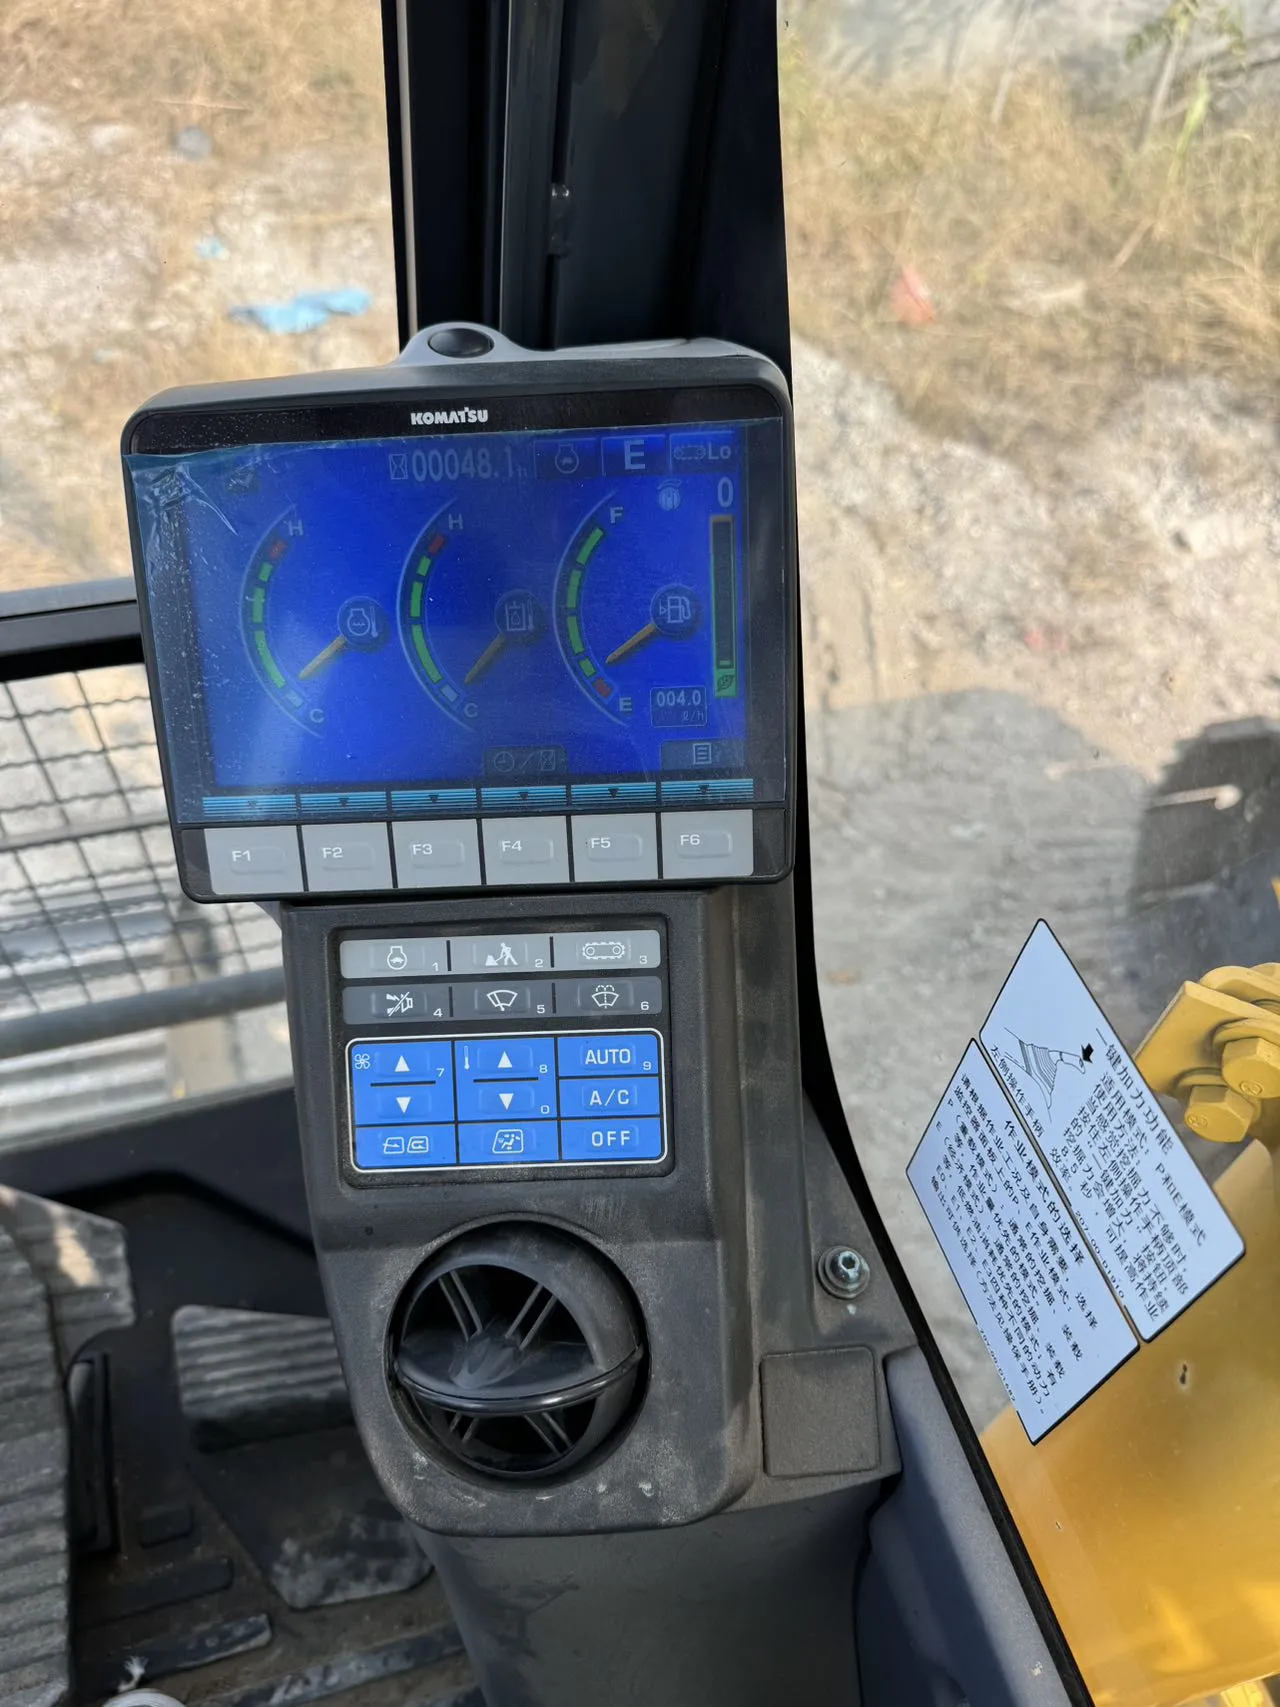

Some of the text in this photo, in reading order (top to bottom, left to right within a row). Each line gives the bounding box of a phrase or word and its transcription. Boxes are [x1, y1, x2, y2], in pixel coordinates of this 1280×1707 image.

[411, 407, 488, 425] KOMATSU
[624, 439, 646, 471] E
[708, 444, 732, 460] Lo
[718, 477, 734, 508] 0
[449, 513, 464, 530] H
[610, 507, 624, 524] F
[288, 520, 304, 536] H
[620, 697, 632, 711] E
[656, 689, 702, 707] 004.0
[309, 709, 324, 723] C
[463, 703, 478, 718] C
[502, 840, 523, 852] F4
[591, 836, 612, 849] F5
[680, 834, 701, 846] F6
[322, 846, 343, 859] F2
[412, 843, 433, 855] F3
[231, 850, 251, 863] F1
[431, 962, 439, 972] 1
[535, 958, 543, 968] 2
[639, 955, 648, 965] 3
[433, 1008, 443, 1018] 4
[536, 1004, 546, 1014] 5
[640, 1001, 650, 1011] 6
[584, 1049, 631, 1065] AUTO
[436, 1068, 444, 1077] 7
[539, 1064, 548, 1073] 8
[642, 1061, 651, 1071] 9
[589, 1088, 630, 1105] A/C
[990, 1041, 1044, 1140] 左侧操作手柄
[1091, 1022, 1175, 1157] 一键加力功能
[591, 1130, 631, 1147] OFF
[1002, 1116, 1086, 1269] 作业模式的选择
